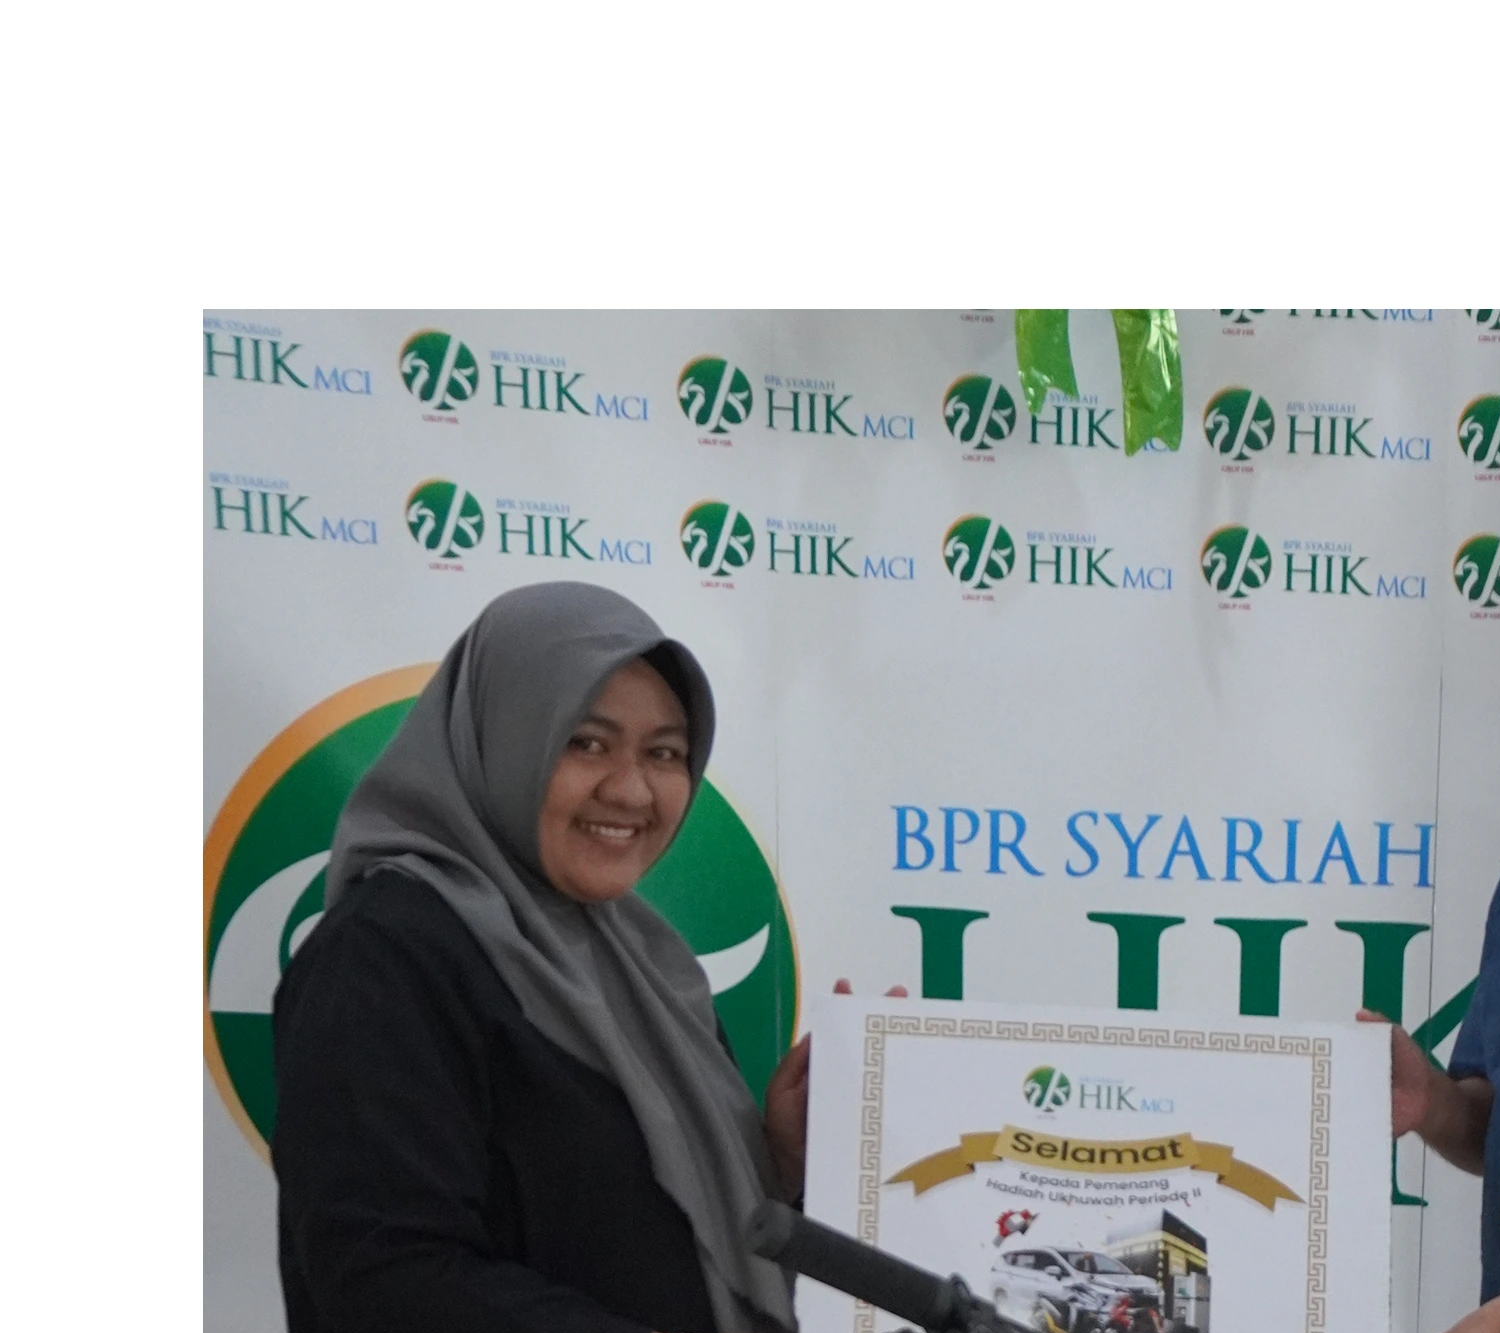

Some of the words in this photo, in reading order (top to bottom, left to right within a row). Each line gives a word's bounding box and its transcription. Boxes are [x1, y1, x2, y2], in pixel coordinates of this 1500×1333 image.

[493, 365, 590, 415] HIK
[596, 396, 648, 421] MCI
[766, 387, 857, 436] HIK
[863, 415, 914, 439] MCI
[1288, 415, 1375, 458] HIK
[1381, 437, 1431, 461] MCI
[213, 487, 316, 539] HIK
[322, 519, 377, 544] MCI
[769, 532, 858, 578] HIK
[864, 556, 914, 580] MCI
[1028, 544, 1117, 587] HIK
[1123, 567, 1172, 590] MCI
[1285, 553, 1371, 596] HIK
[1377, 575, 1426, 599] MCI
[891, 805, 1045, 877] BPR
[1065, 810, 1434, 888] SYARIAH
[1079, 1084, 1137, 1111] HIK
[1140, 1099, 1174, 1113] MCI
[1011, 1133, 1184, 1163] Selamat
[986, 1178, 1043, 1199] Hadiah
[1049, 1191, 1124, 1205] Ukhuwah
[1129, 1191, 1188, 1205] Periode
[1193, 1188, 1201, 1196] II
[1019, 1171, 1079, 1188] Kepada
[1084, 1178, 1169, 1189] Pemenang
